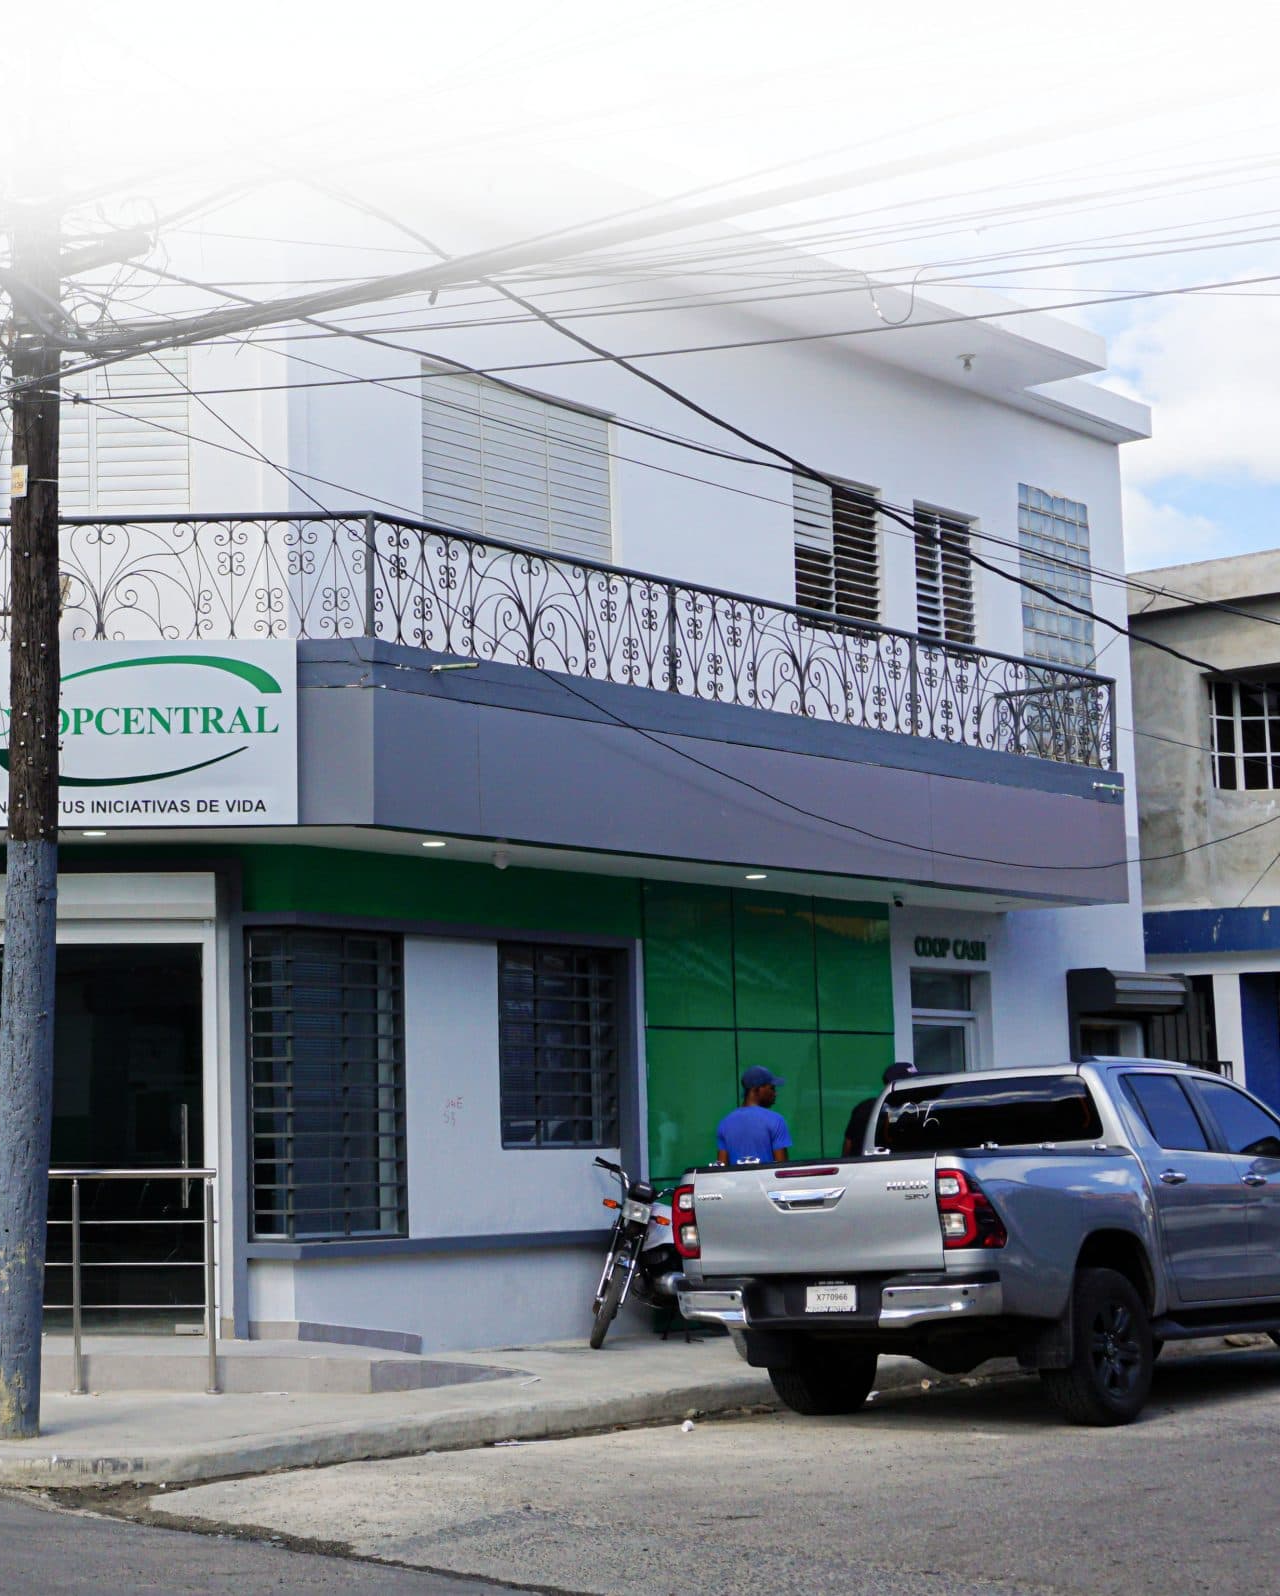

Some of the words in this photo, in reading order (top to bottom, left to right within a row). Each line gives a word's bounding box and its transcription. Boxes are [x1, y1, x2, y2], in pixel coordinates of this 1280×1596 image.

[90, 799, 191, 814] INICIATIVAS
[196, 799, 220, 813] DE
[225, 798, 267, 813] VIDA
[914, 935, 951, 958] COOP
[952, 939, 987, 961] CASH
[886, 1179, 929, 1191] HILUX
